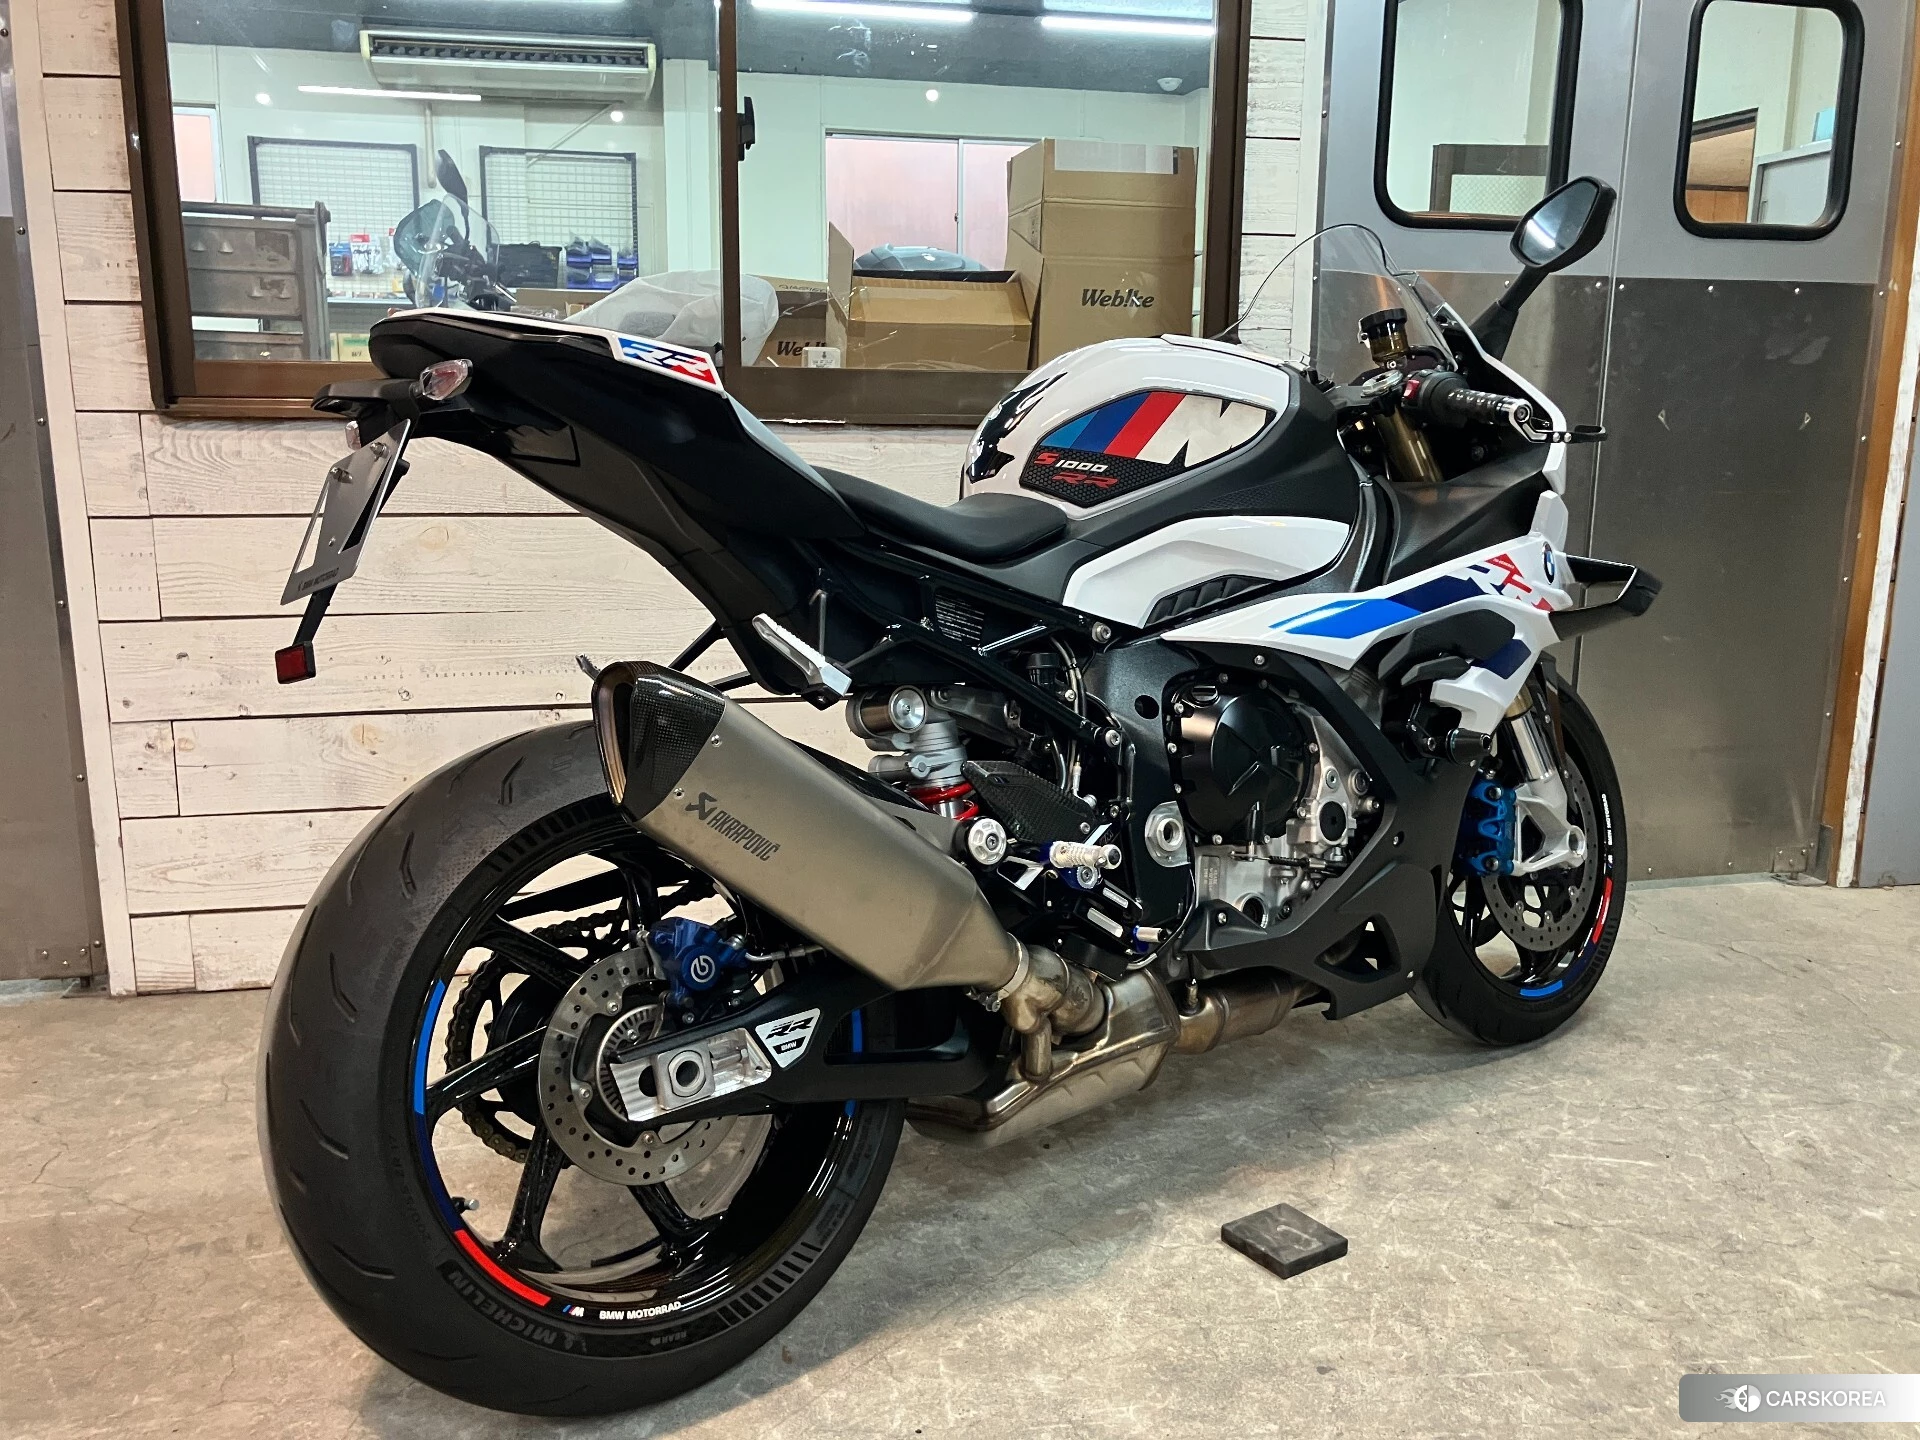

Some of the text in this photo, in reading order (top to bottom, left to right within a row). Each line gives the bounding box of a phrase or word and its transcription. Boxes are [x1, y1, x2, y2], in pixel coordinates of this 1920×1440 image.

[1052, 471, 1119, 489] RR
[766, 1017, 814, 1039] RR
[780, 1041, 797, 1051] BMW
[448, 1270, 558, 1345] MICHELIN
[599, 1310, 625, 1320] BMW
[626, 1301, 681, 1319] MOTORRAD
